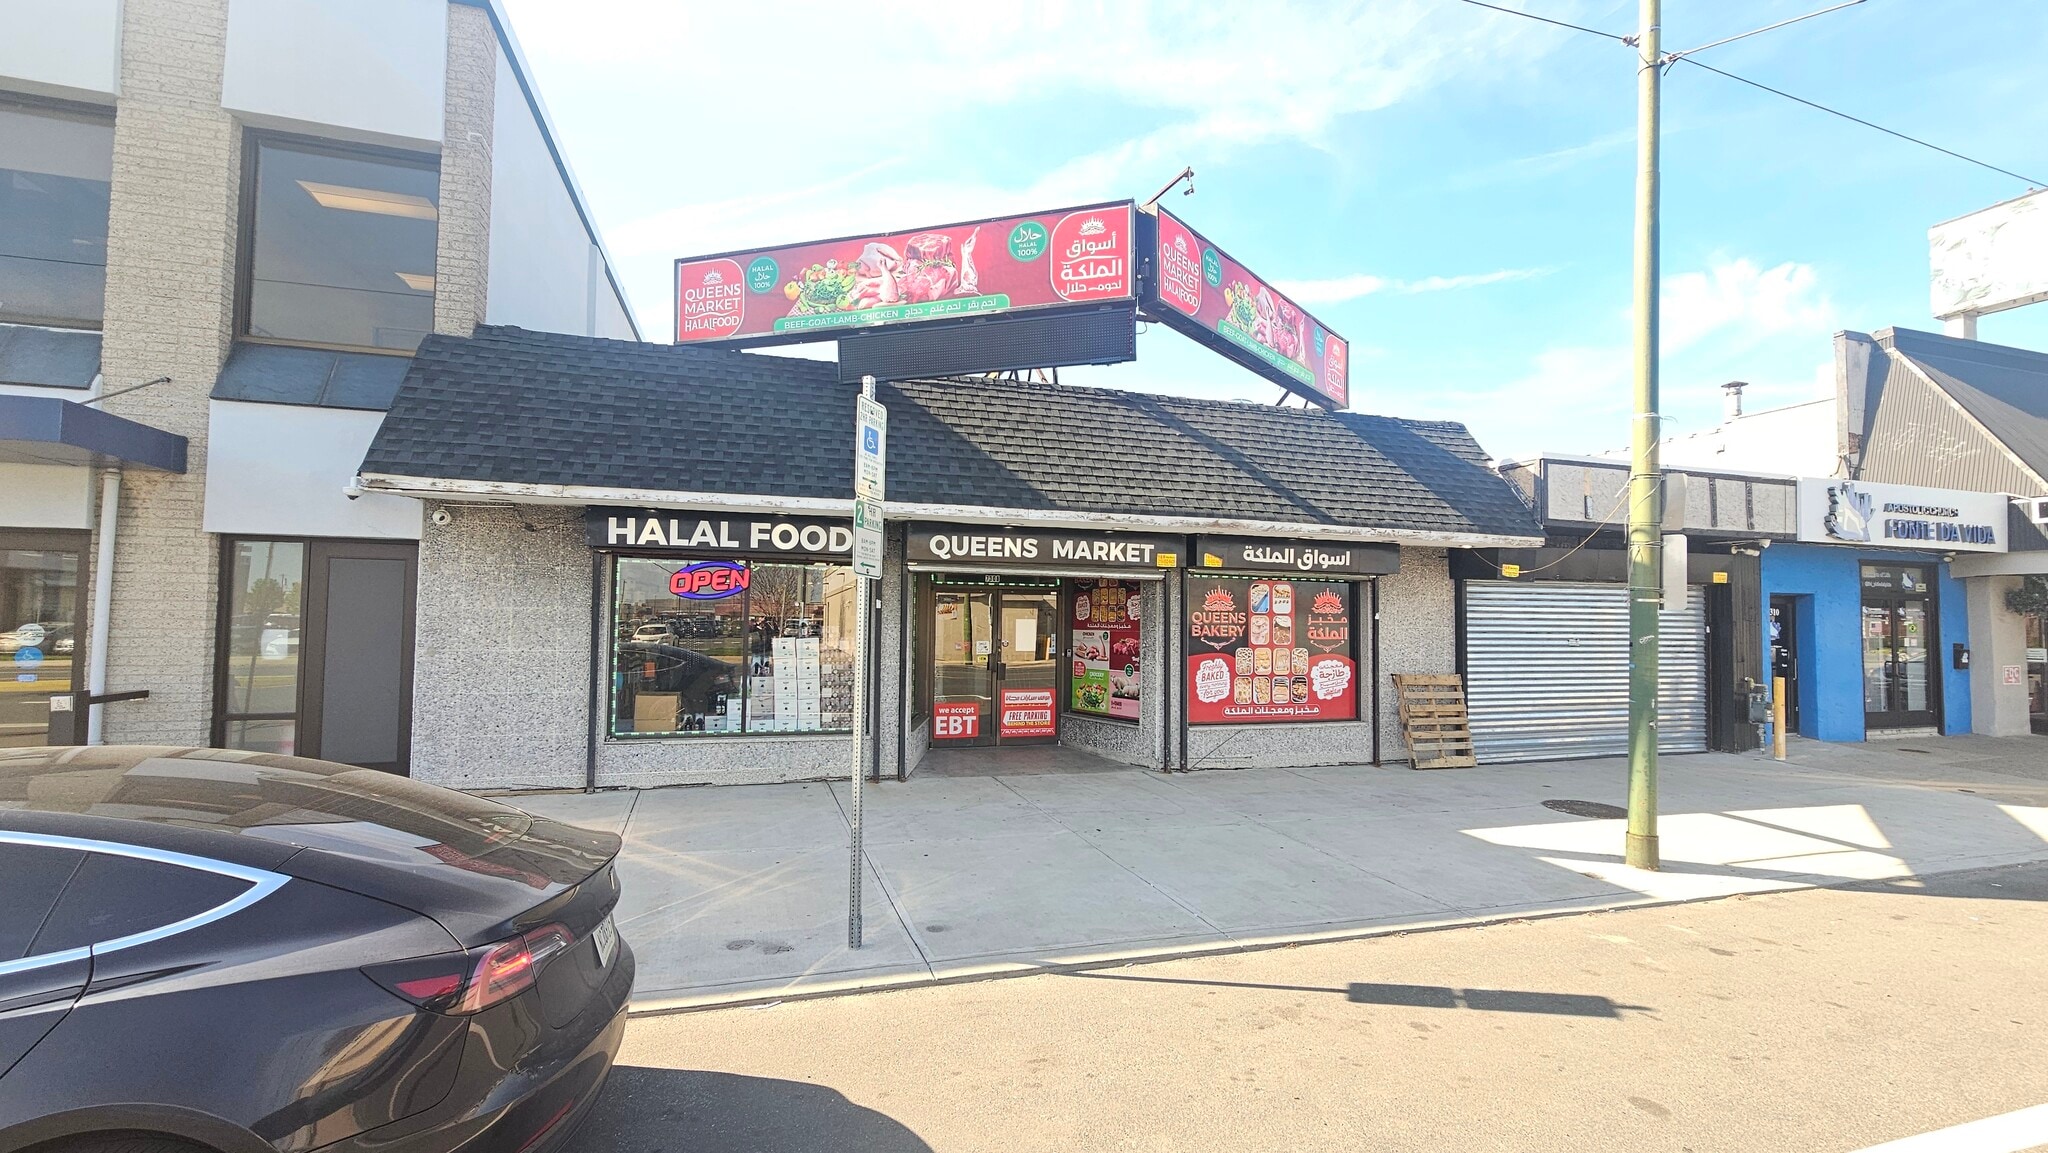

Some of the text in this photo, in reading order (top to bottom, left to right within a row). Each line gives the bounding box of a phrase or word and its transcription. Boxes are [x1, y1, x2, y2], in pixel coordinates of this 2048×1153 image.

[1014, 227, 1042, 243] حلال
[1066, 231, 1117, 258] أسواق
[1017, 248, 1038, 257] 100%
[1163, 243, 1199, 276] QUEENS
[752, 265, 774, 273] HALAL
[1060, 258, 1122, 280] الملكة
[1163, 257, 1199, 290] MARKET
[754, 281, 771, 289] 100%
[1060, 282, 1087, 296] حلال
[1164, 276, 1198, 308] HALAL FOOD
[685, 283, 741, 302] QUEENS
[685, 297, 741, 314] MARKET
[946, 302, 961, 314] لحم
[981, 298, 996, 310] لحم
[904, 307, 923, 319] دجاج
[685, 316, 740, 332] HALAL FOOD
[857, 504, 863, 524] 2
[607, 517, 853, 551] HALAL FOOD
[1939, 522, 1960, 542] DA
[1962, 525, 1995, 544] VIDA
[929, 534, 1038, 559] QUEENS
[1052, 540, 1155, 563] MARKET
[1243, 545, 1295, 564] الملكة
[1297, 549, 1351, 570] اسواق
[669, 569, 750, 595] OPEN
[1191, 611, 1246, 625] QUEENS
[1308, 614, 1347, 625] مخبز
[1191, 625, 1246, 637] BAKERY
[1307, 626, 1348, 640] الملكة
[1201, 671, 1225, 682] BAKED
[1319, 669, 1345, 680] طازجة
[2004, 667, 2019, 678] FDC
[1203, 689, 1213, 698] for
[950, 706, 975, 715] accept
[1009, 711, 1048, 721] FREE PARKING
[1224, 705, 1319, 716] مخبز ومعجنات الملكة
[935, 715, 977, 735] EBT
